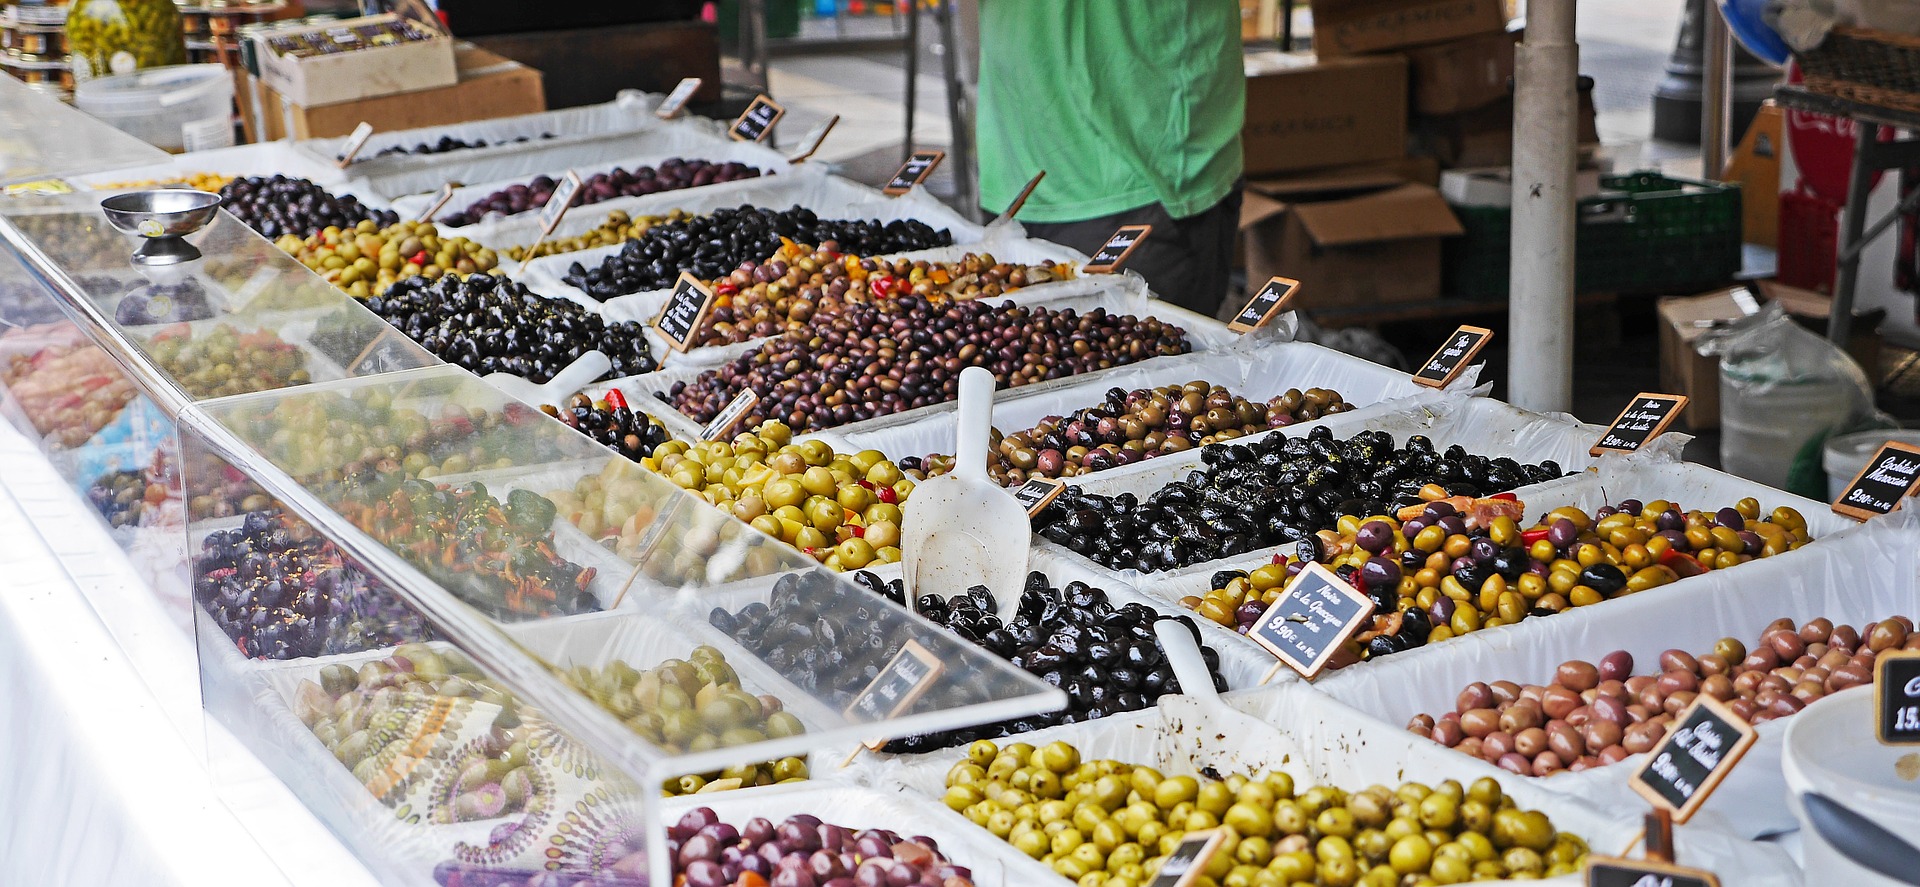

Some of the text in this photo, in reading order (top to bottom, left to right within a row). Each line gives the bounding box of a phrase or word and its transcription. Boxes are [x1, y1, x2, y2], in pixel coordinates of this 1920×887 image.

[1865, 468, 1909, 487] Marocain
[1316, 584, 1342, 606] Noire
[1292, 590, 1343, 628] à la Grecque
[1268, 616, 1298, 644] 9.90€
